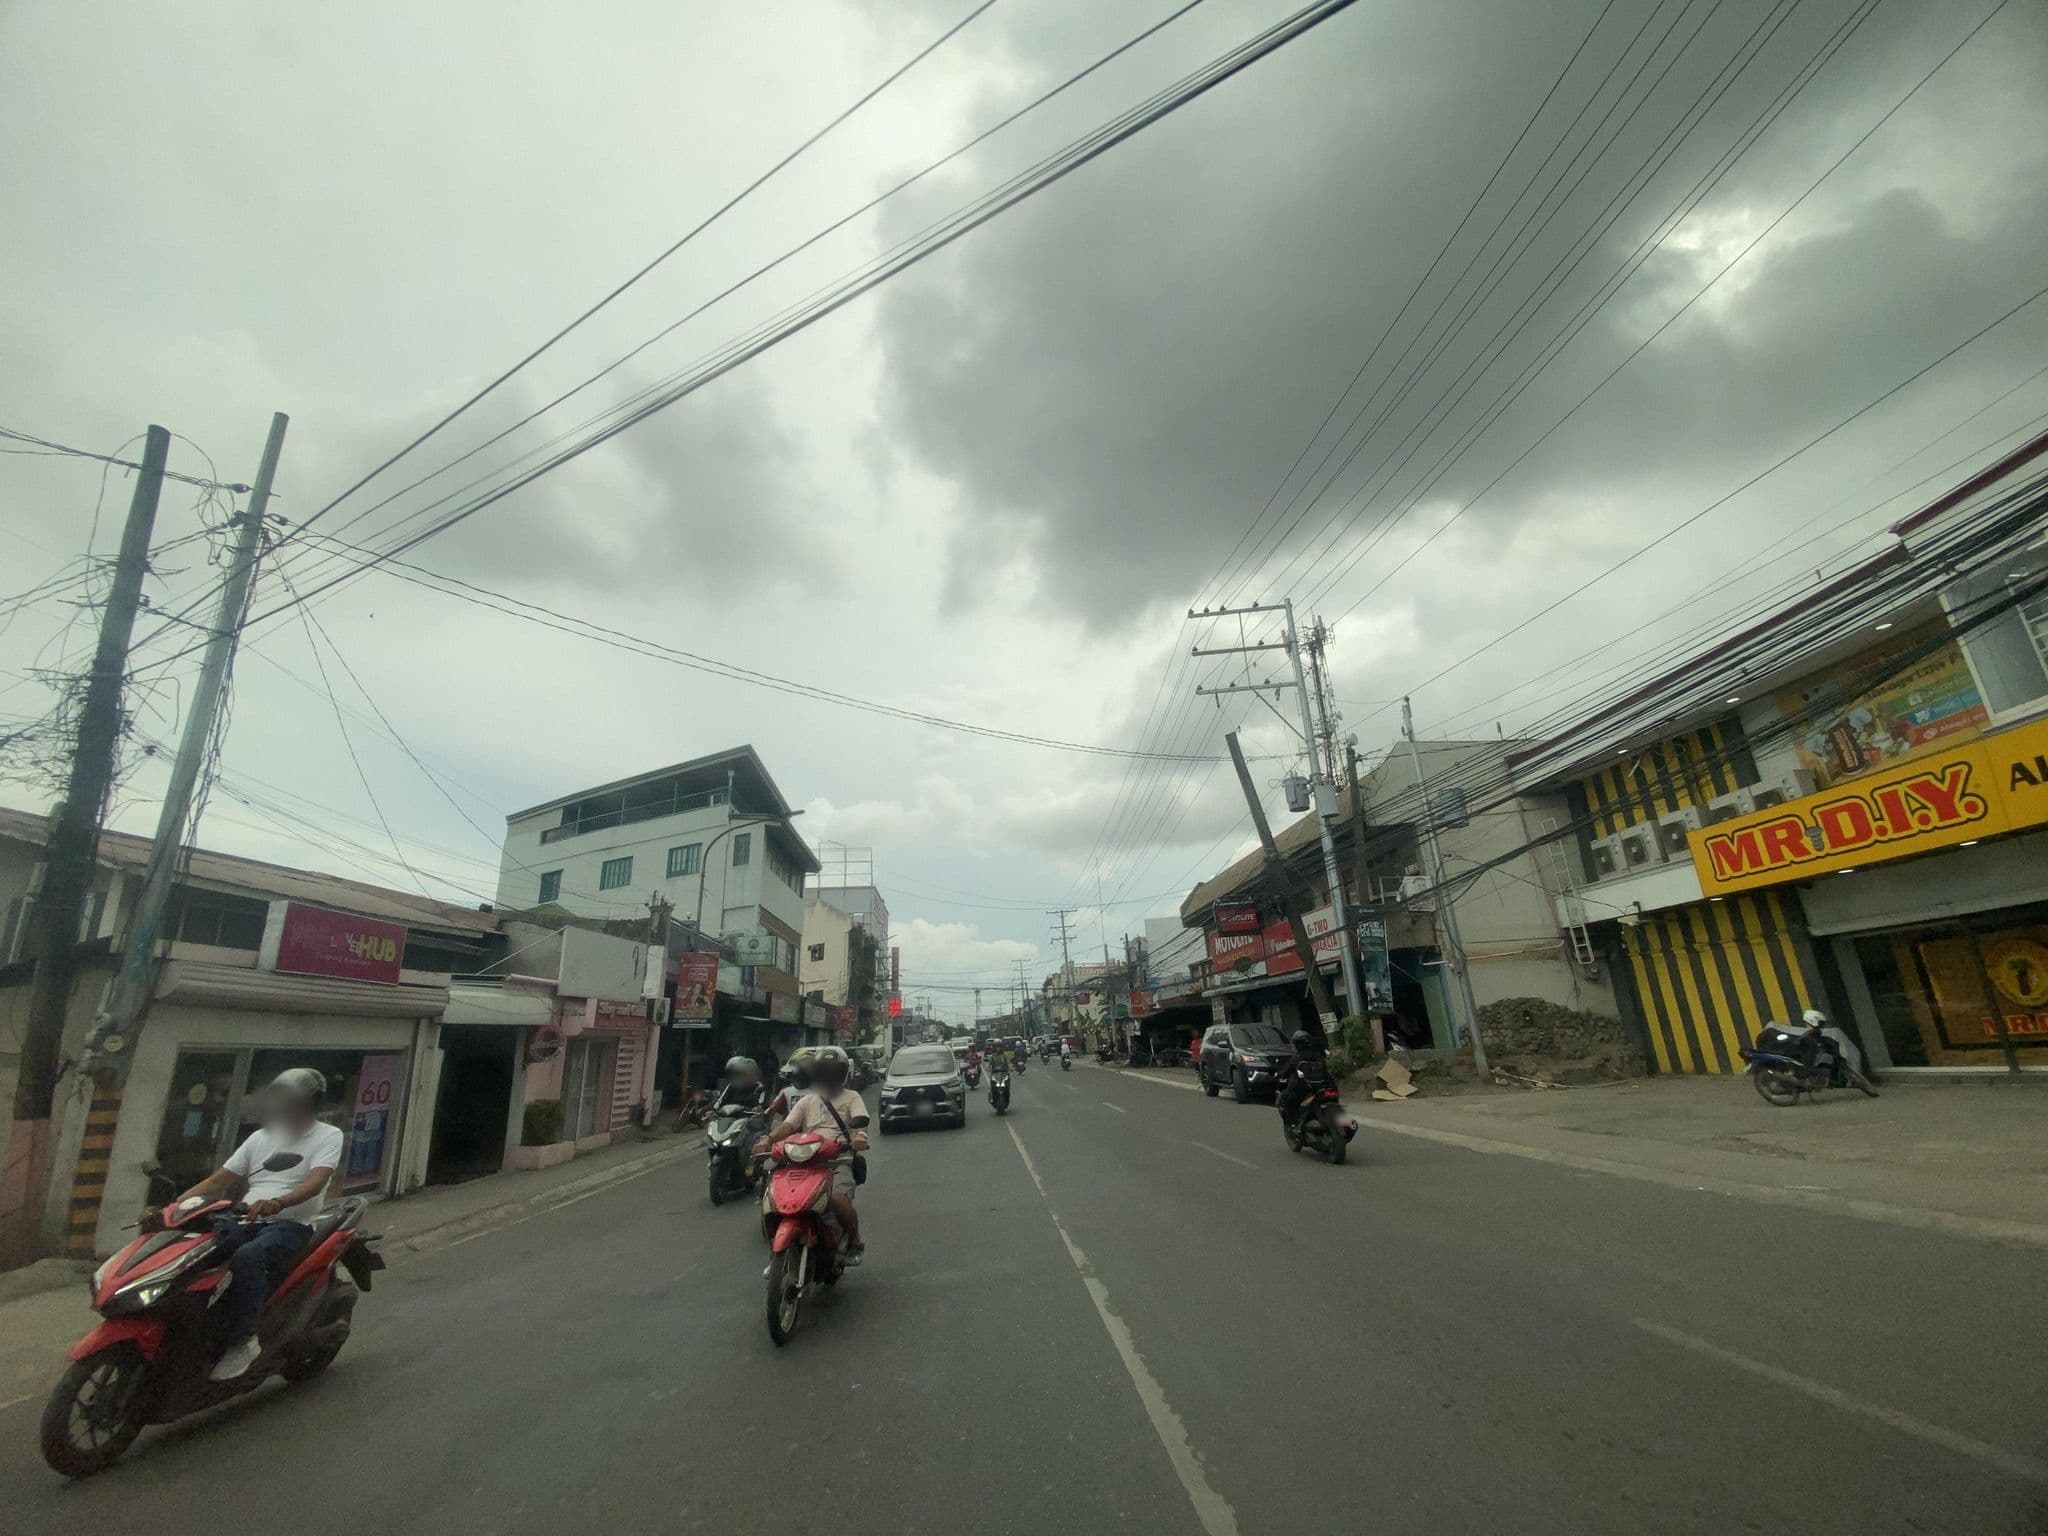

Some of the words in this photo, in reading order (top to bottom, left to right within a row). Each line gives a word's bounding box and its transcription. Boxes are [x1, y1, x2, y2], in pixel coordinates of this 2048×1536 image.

[1306, 918, 1328, 937] G-TWO
[359, 934, 397, 963] HUB
[361, 1080, 391, 1106] 60
